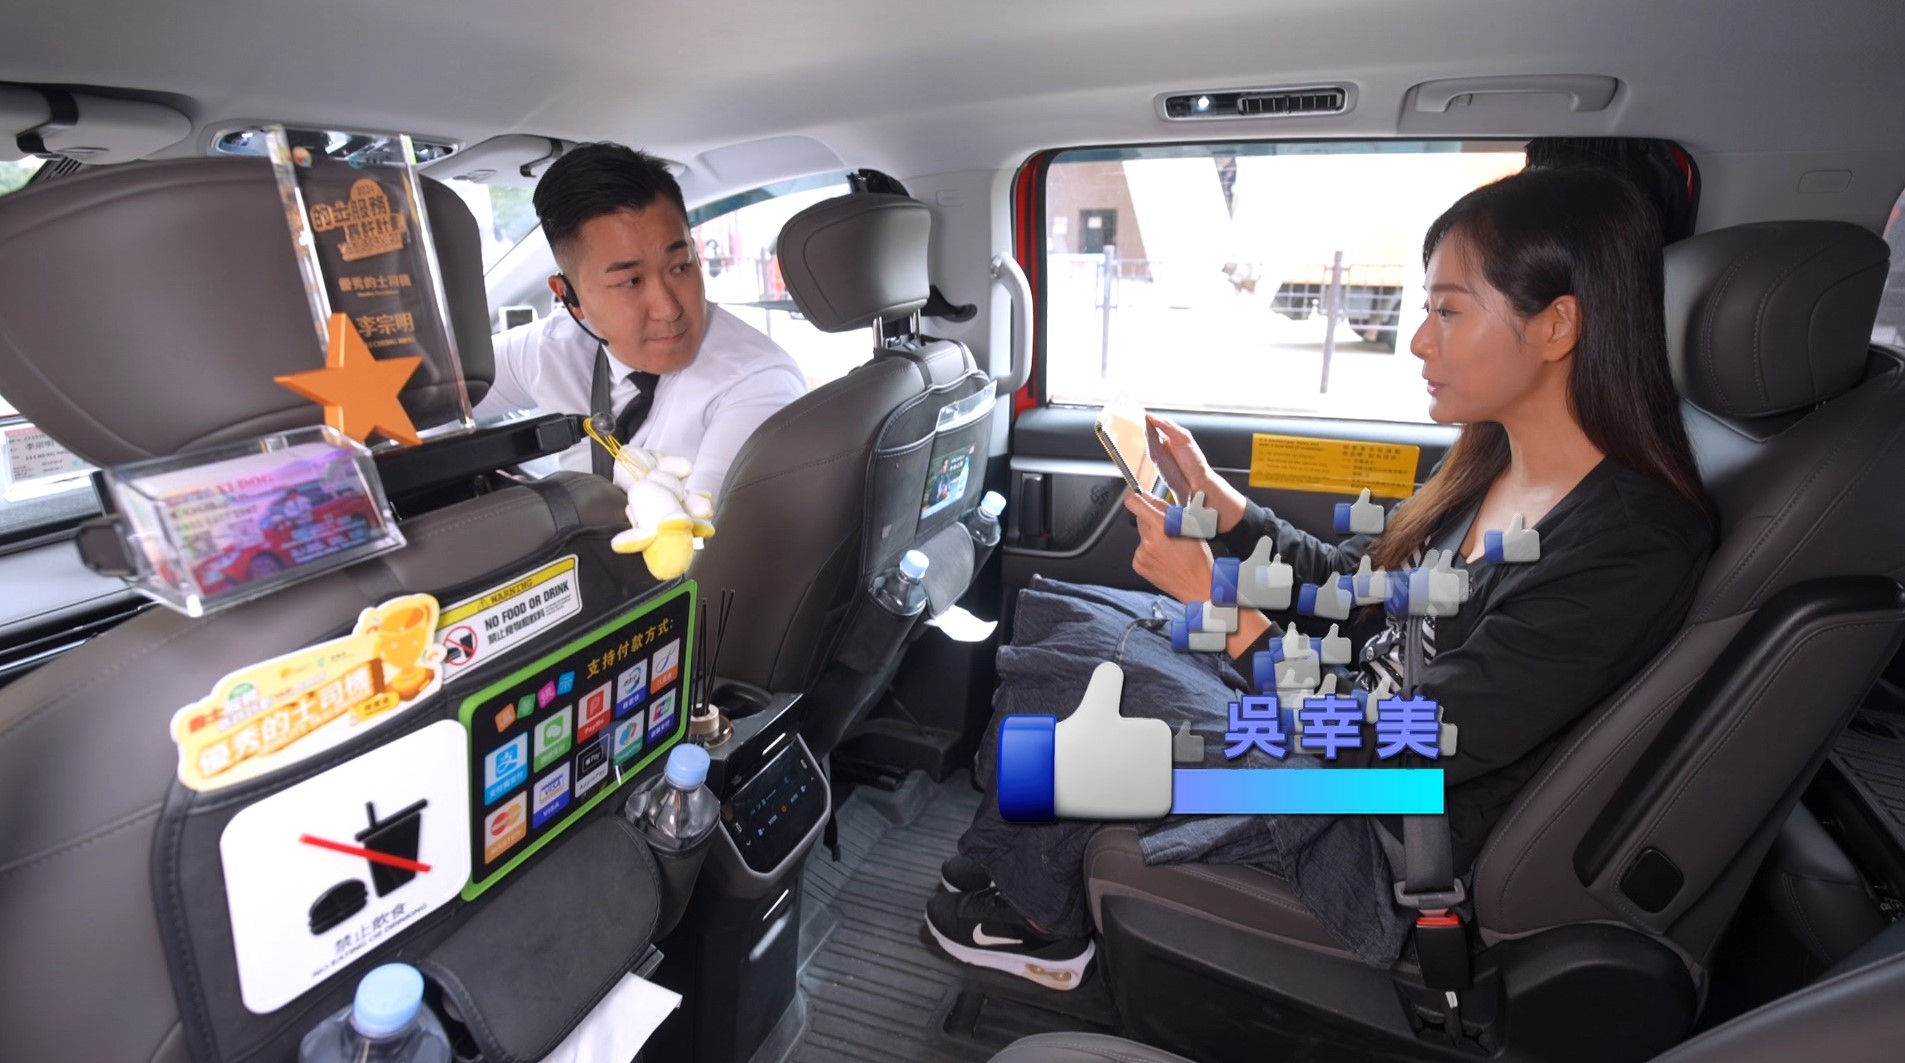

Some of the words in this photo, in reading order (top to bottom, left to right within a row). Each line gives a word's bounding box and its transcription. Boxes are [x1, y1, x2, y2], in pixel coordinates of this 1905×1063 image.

[356, 312, 415, 337] 李宗明
[489, 578, 533, 604] WARNING
[484, 615, 500, 632] NO
[501, 601, 527, 624] FOOD
[528, 594, 542, 611] OR
[543, 579, 570, 603] DRINK
[543, 777, 563, 797] VISA
[542, 801, 560, 817] VISA
[335, 902, 406, 954] 禁止飲食
